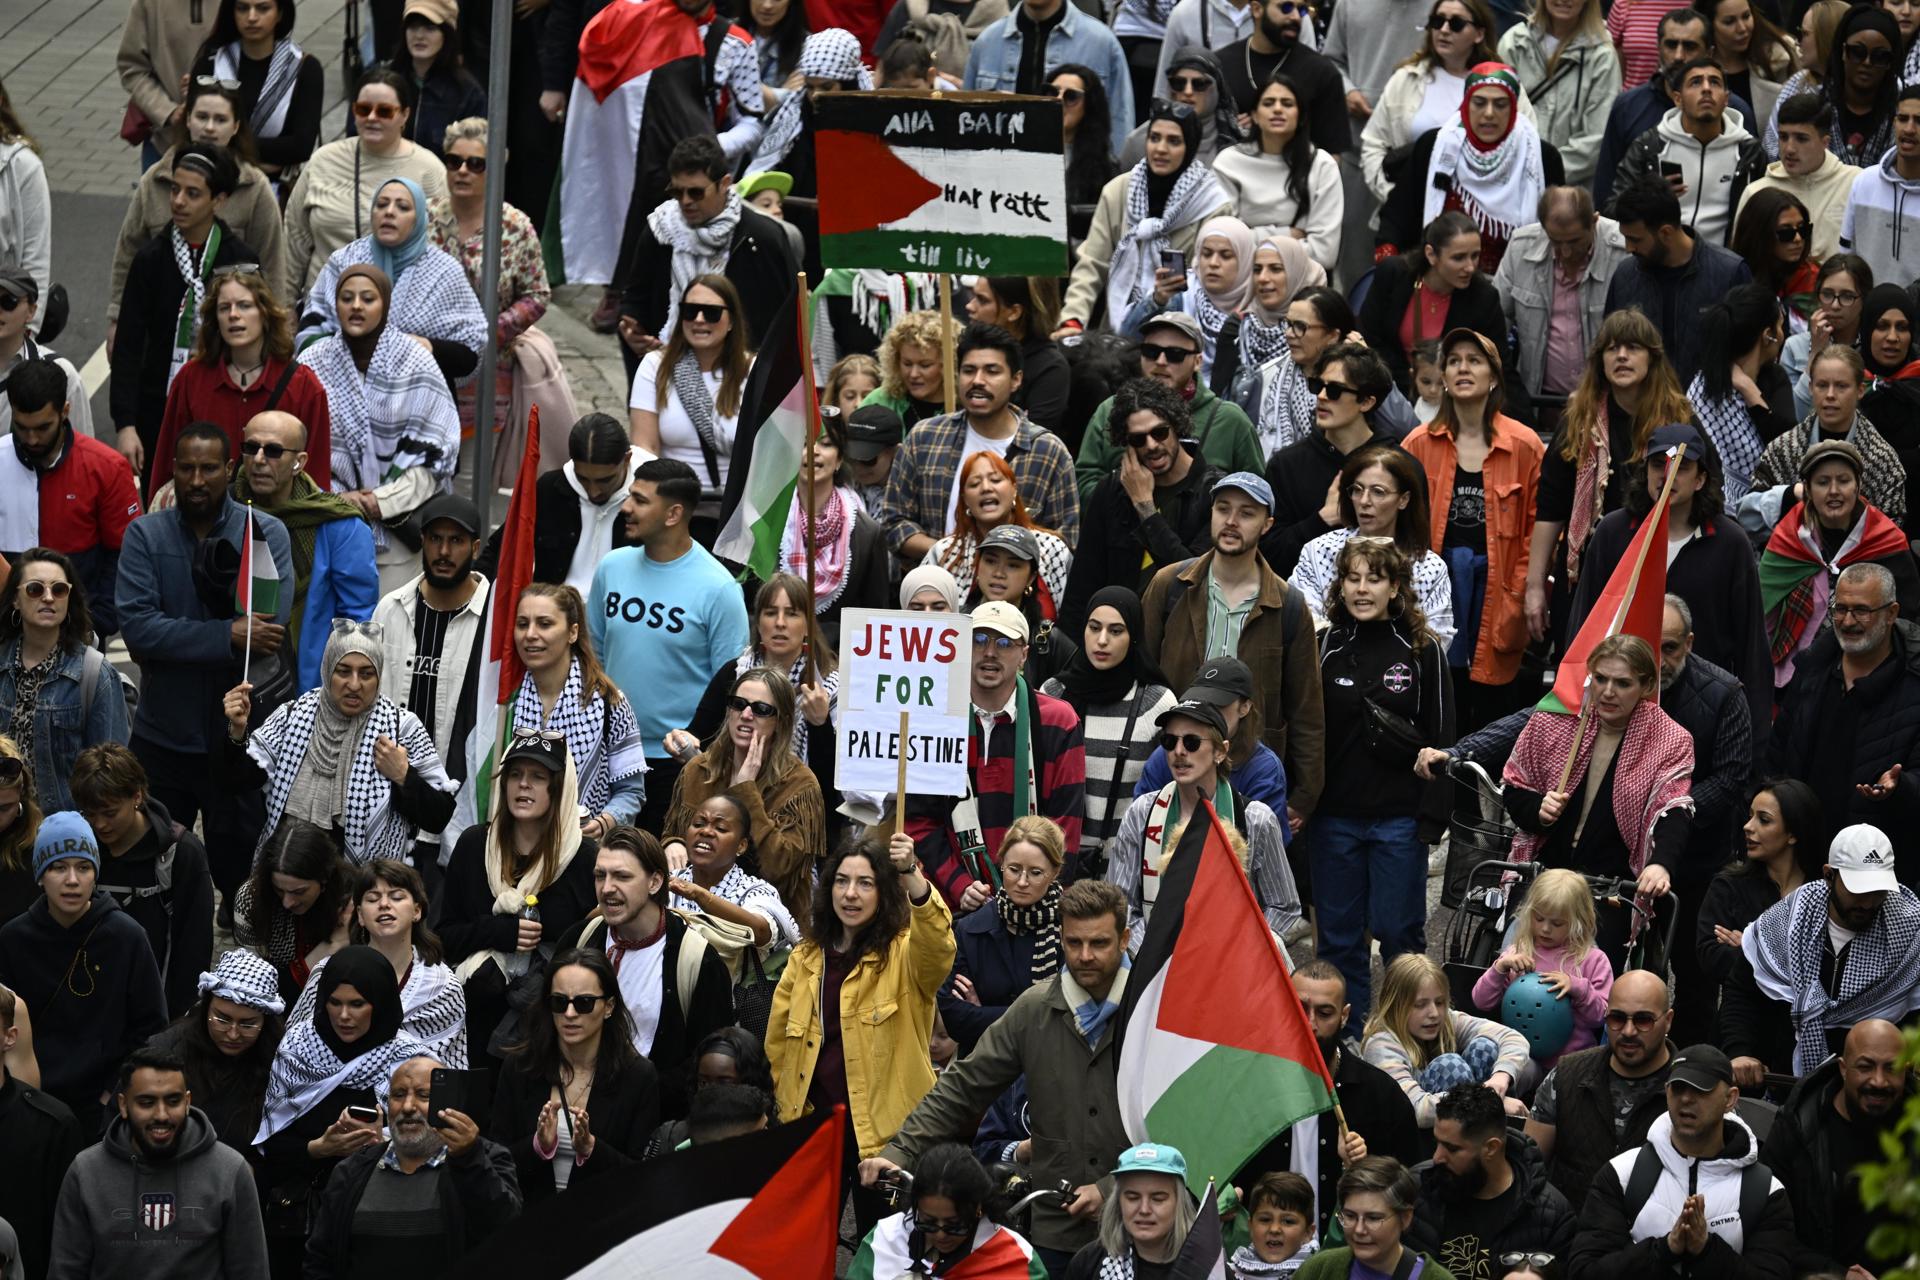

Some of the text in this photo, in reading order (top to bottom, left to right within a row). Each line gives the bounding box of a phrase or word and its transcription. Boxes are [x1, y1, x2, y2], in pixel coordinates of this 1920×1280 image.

[900, 241, 992, 269] till liv
[606, 591, 686, 634] BOSS
[852, 623, 960, 664] JEWS
[876, 674, 935, 707] FOR
[848, 730, 966, 764] PALESTINE
